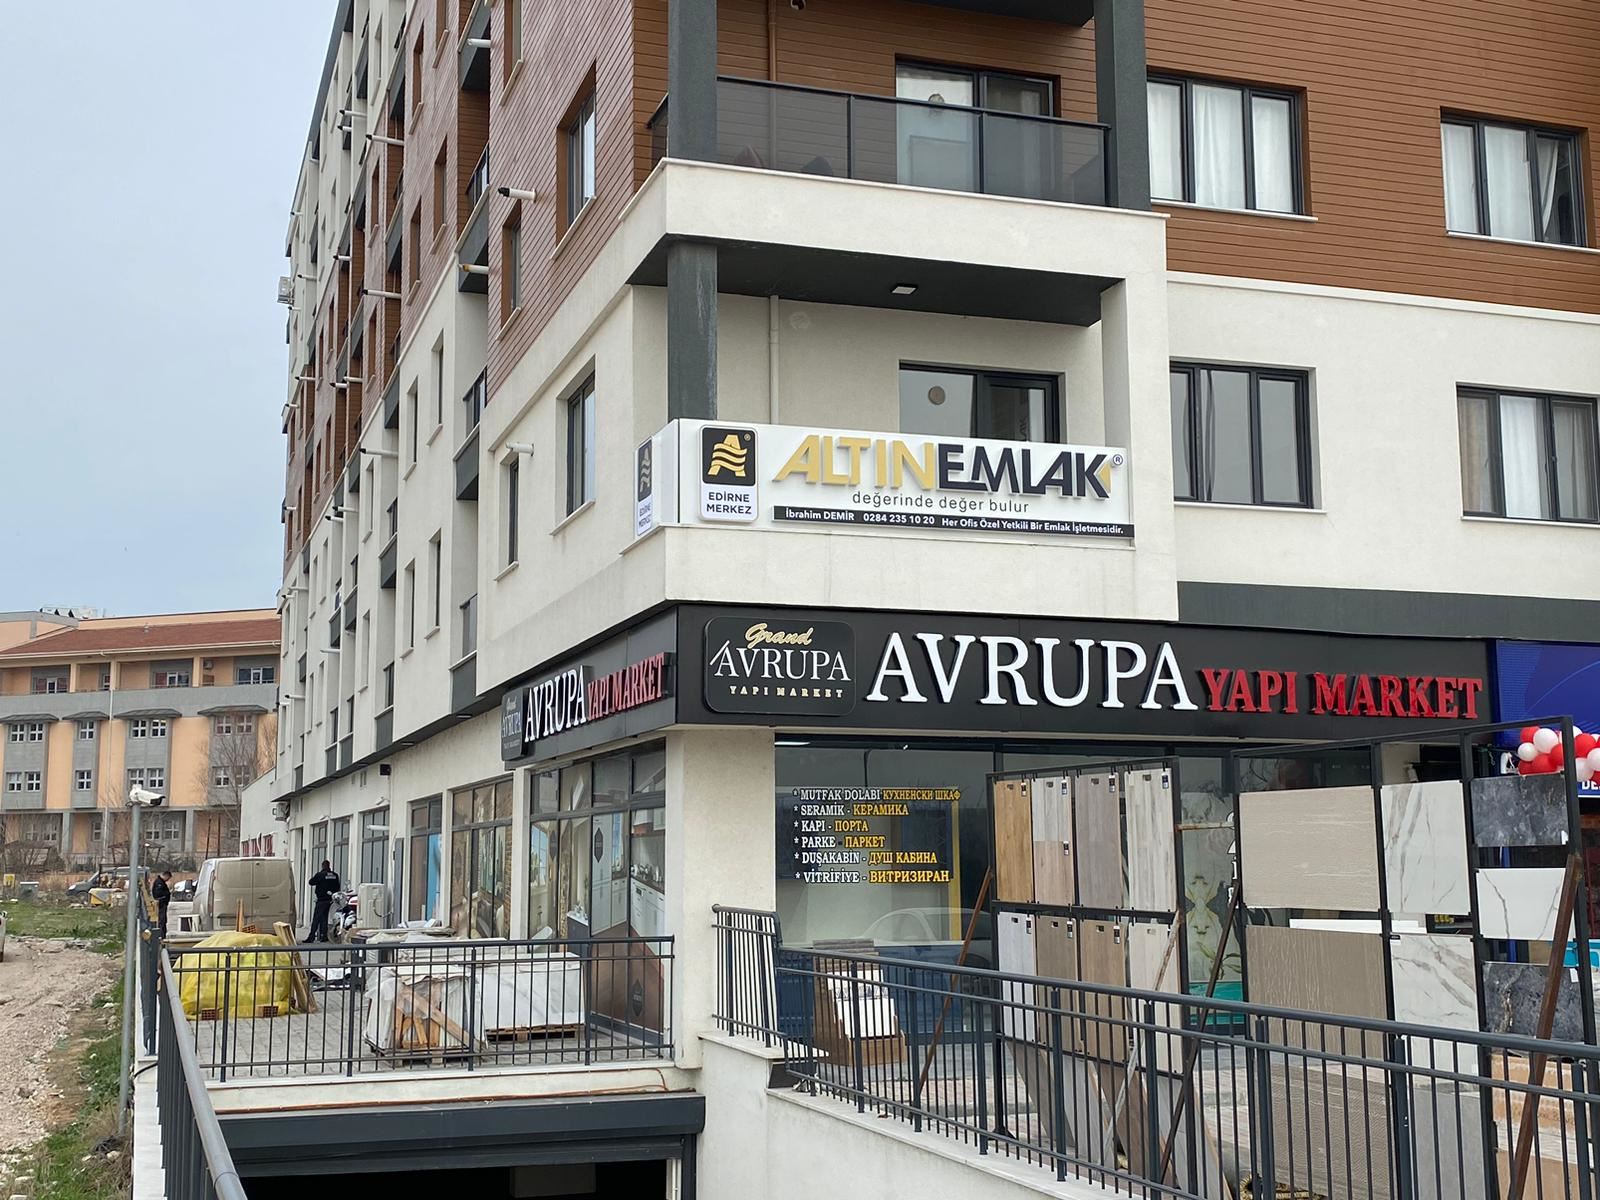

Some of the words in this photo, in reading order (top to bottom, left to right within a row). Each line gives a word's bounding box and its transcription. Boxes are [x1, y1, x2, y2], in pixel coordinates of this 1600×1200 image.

[708, 491, 750, 502] EDİRNE
[852, 491, 934, 508] değerinde
[938, 496, 985, 513] değer
[989, 498, 1029, 513] bulur
[706, 504, 752, 514] MERKEZ
[785, 507, 822, 519] İbrahim
[823, 509, 855, 521] DEMİR
[863, 513, 887, 523] 0284
[889, 514, 907, 523] 235
[909, 515, 921, 524] 10
[923, 516, 935, 525] 20
[941, 518, 958, 527] Her
[959, 518, 978, 528] Ofis
[979, 518, 1000, 529] Özel
[1001, 520, 1029, 530] Yetkili
[1030, 522, 1043, 531] Bir
[1044, 523, 1071, 532] Emlak
[745, 622, 814, 649] Grand
[866, 631, 1199, 711] AVRUPA
[1201, 667, 1299, 714] YAPI
[1311, 672, 1483, 720] MARKET
[524, 665, 587, 743] AVRUPA
[587, 674, 611, 722] YAPI
[613, 652, 665, 711] MARKET
[729, 685, 769, 695] YAPI
[776, 687, 844, 698] MARKET
[1581, 779, 1600, 791] DE
[800, 789, 842, 800] MUTFAK
[844, 789, 881, 800] DOLABI
[935, 790, 961, 800] ШКАФ
[800, 802, 845, 816] SERAMİK
[853, 804, 909, 816] КЕРАМИКА
[801, 820, 826, 832] KAPI
[834, 820, 869, 832] ПОРТА
[801, 836, 836, 848] PARKE
[844, 836, 885, 848] ПАРКЕТ
[868, 852, 893, 865] ДУШ
[896, 852, 937, 864] КАБИНА
[803, 868, 860, 883] VİTRİFİYE
[869, 870, 950, 883] ВИТРИЗИРАН
